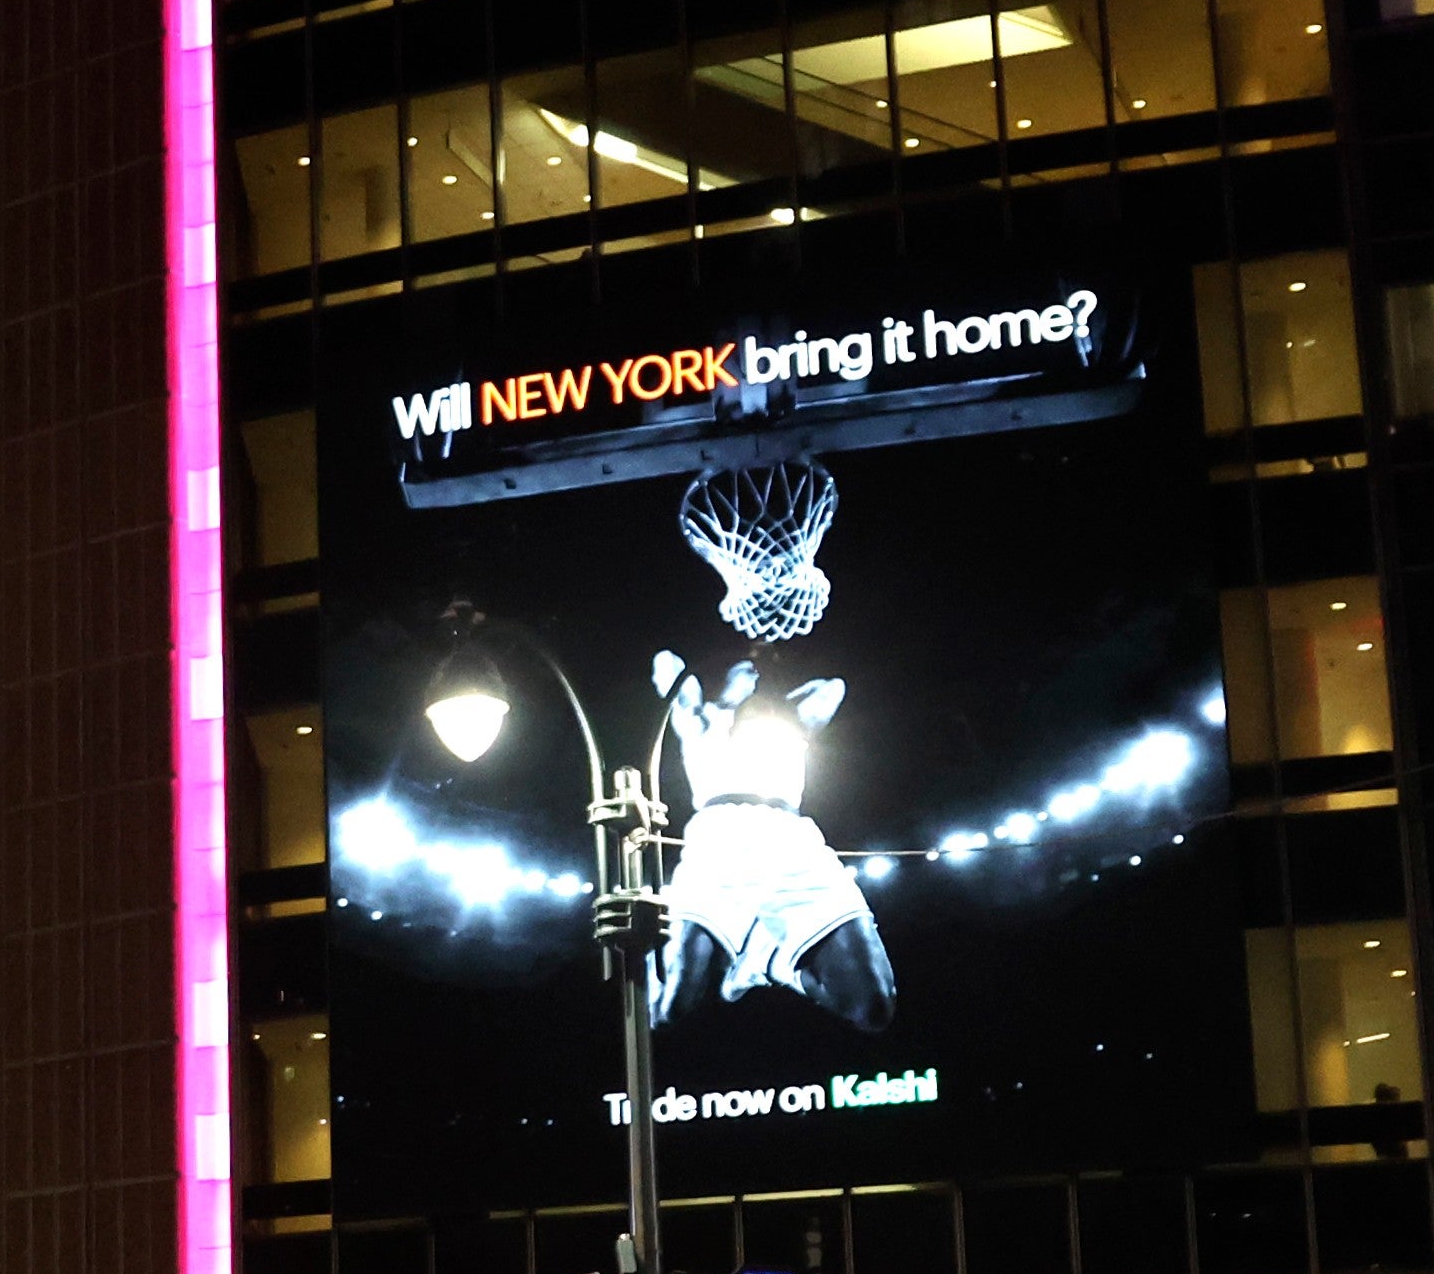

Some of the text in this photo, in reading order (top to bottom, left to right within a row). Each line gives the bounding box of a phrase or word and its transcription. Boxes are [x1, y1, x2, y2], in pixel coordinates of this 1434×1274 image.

[392, 289, 1098, 439] Will NEW YORK bring it home?
[602, 1068, 938, 1125] Trde now on Kalshi
